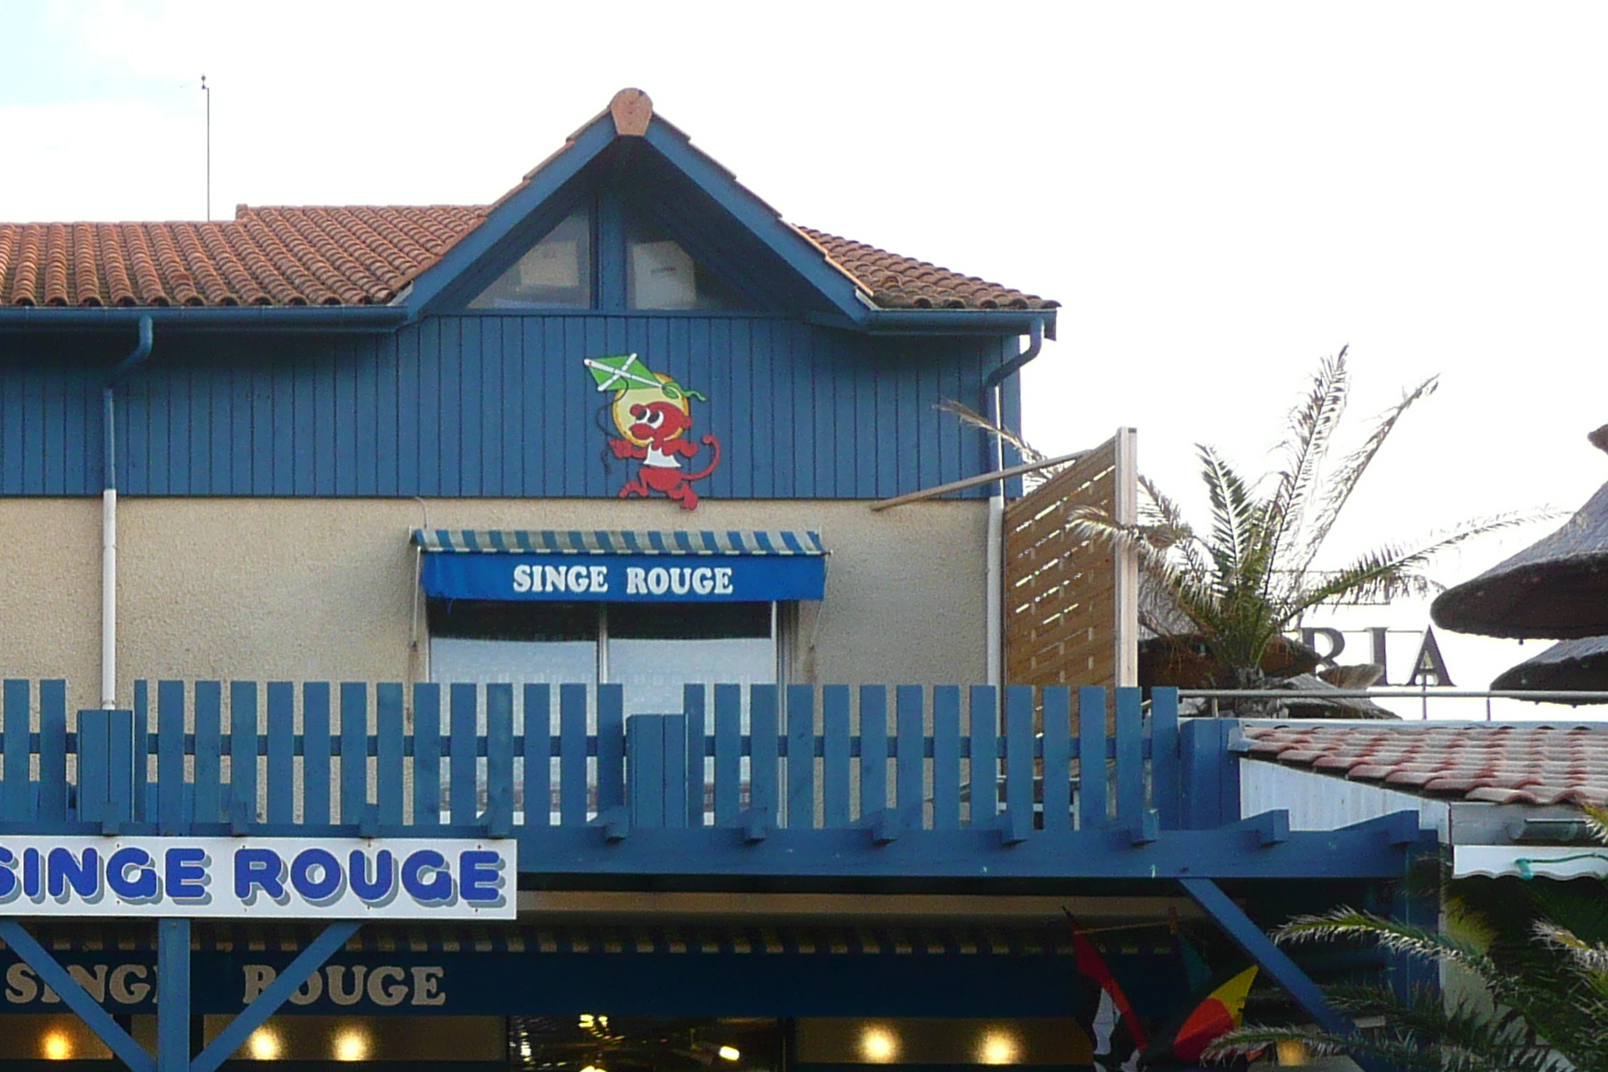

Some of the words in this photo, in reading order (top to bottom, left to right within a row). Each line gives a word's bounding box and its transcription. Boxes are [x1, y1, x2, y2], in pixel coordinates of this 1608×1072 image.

[513, 565, 608, 592] SINGE
[626, 567, 733, 595] ROUGE
[233, 848, 506, 908] ROUGE
[5, 962, 159, 1005] SNG
